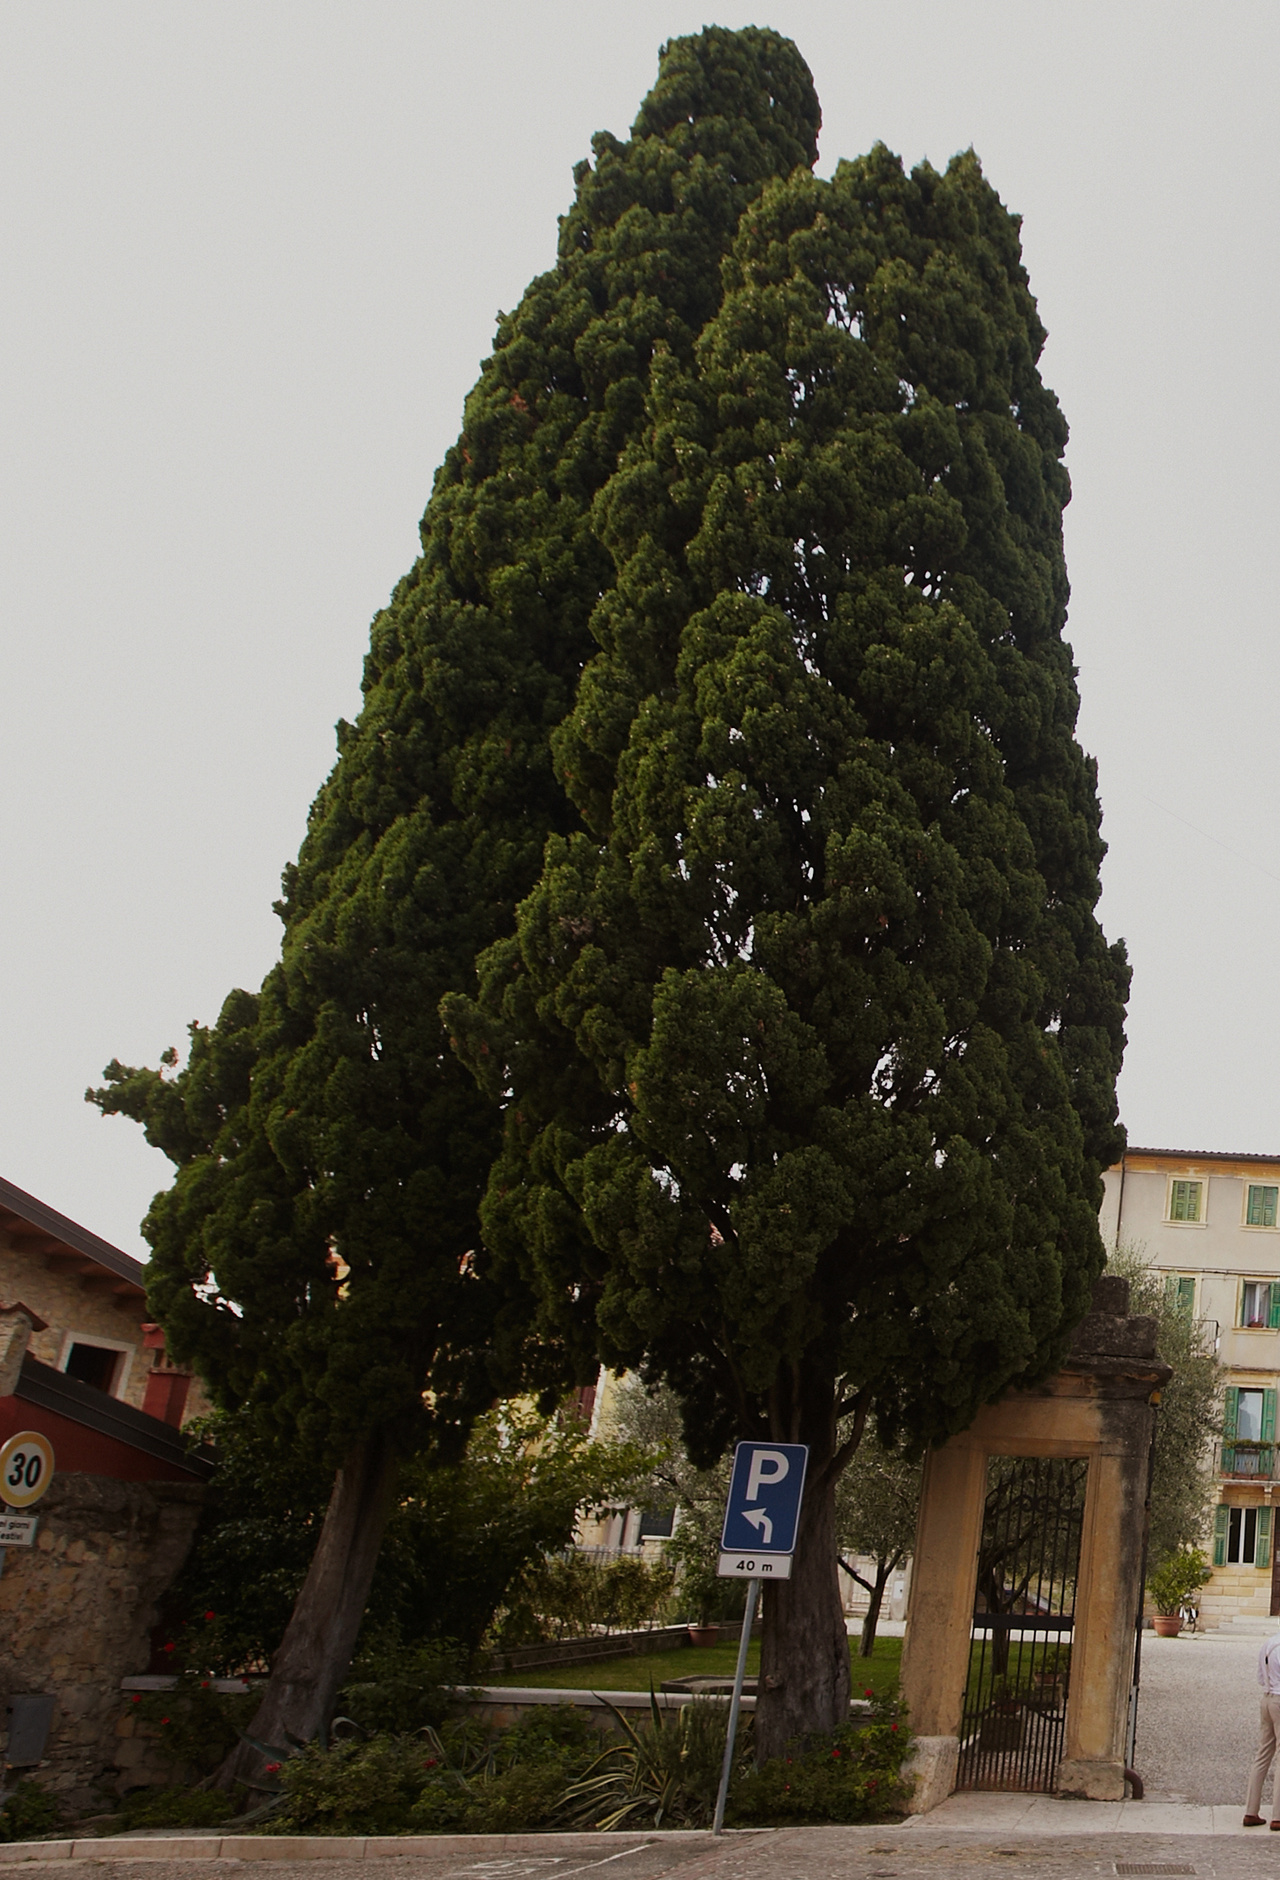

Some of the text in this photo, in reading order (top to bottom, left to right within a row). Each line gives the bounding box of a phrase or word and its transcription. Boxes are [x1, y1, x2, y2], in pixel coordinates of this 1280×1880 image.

[8, 1452, 42, 1488] 30
[745, 1449, 790, 1501] P
[0, 1531, 23, 1540] estivi
[736, 1560, 773, 1572] 40 m
